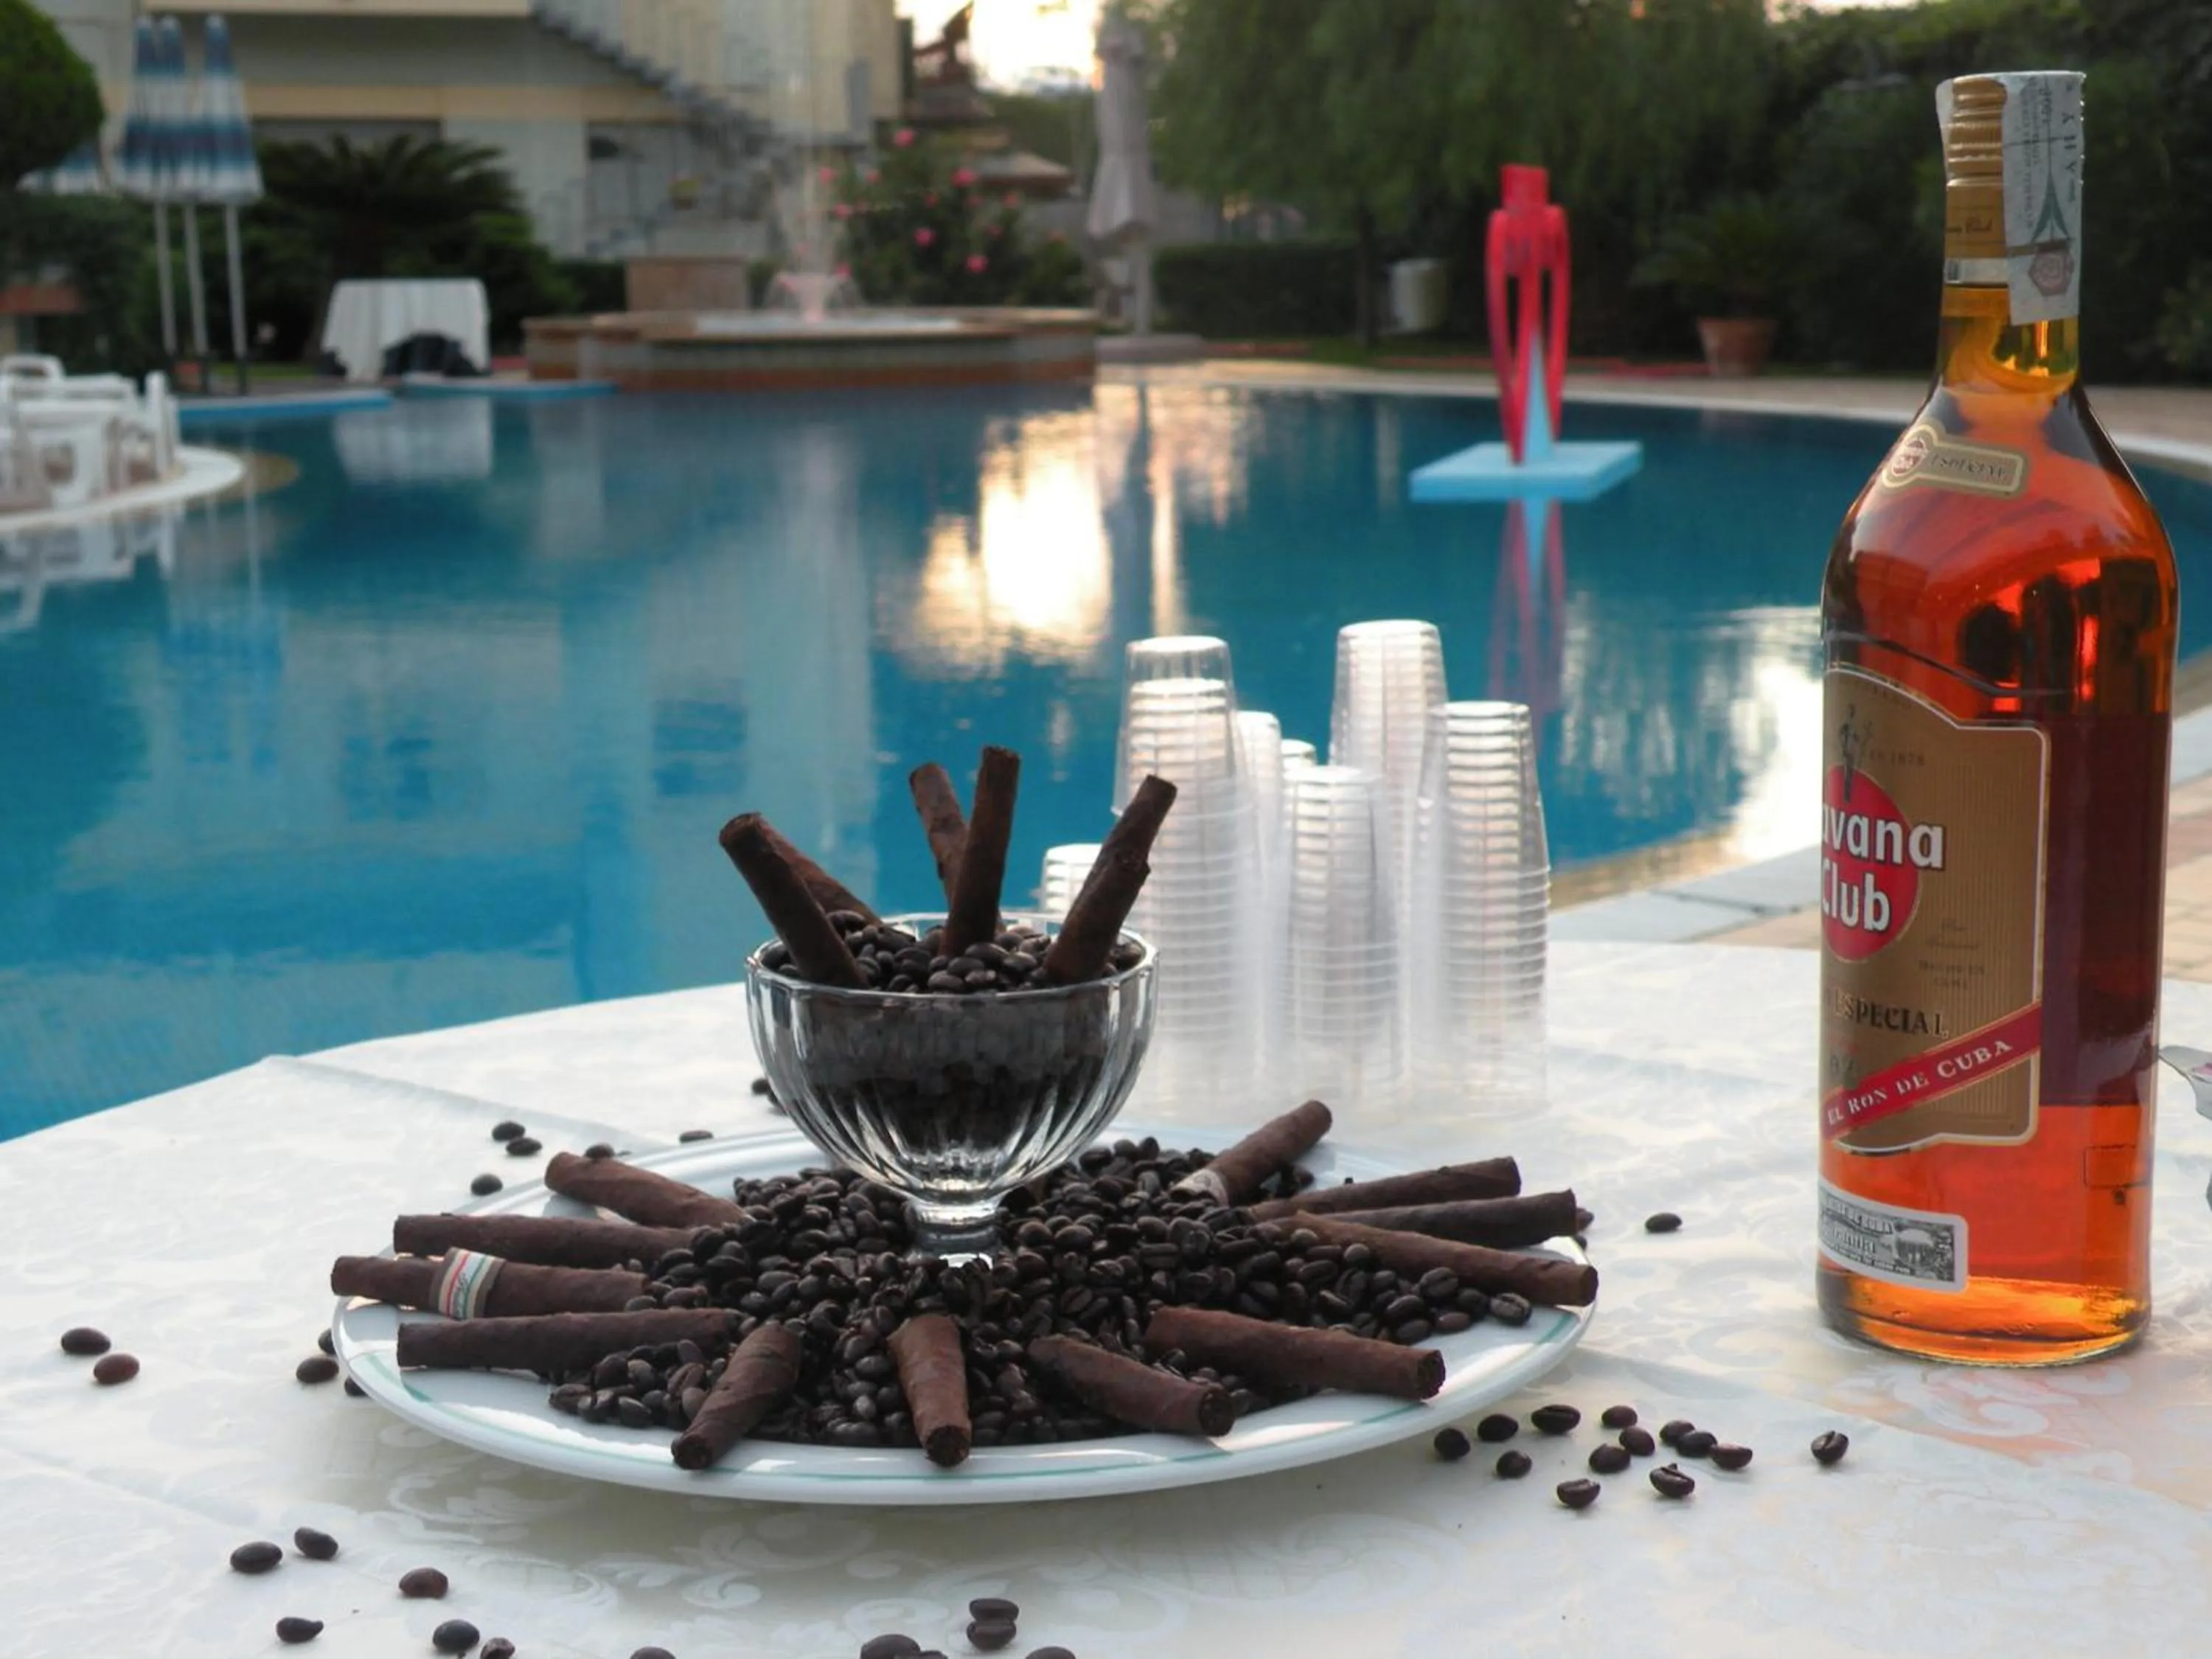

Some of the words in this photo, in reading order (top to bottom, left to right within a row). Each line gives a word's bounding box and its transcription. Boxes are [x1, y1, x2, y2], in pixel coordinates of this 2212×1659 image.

[1835, 989, 1944, 1037] ESPECIAL
[1828, 1107, 1844, 1125] EL
[1848, 1088, 1888, 1114] RON
[1896, 1072, 1930, 1096] DE
[1936, 1040, 2014, 1078] CUBA
